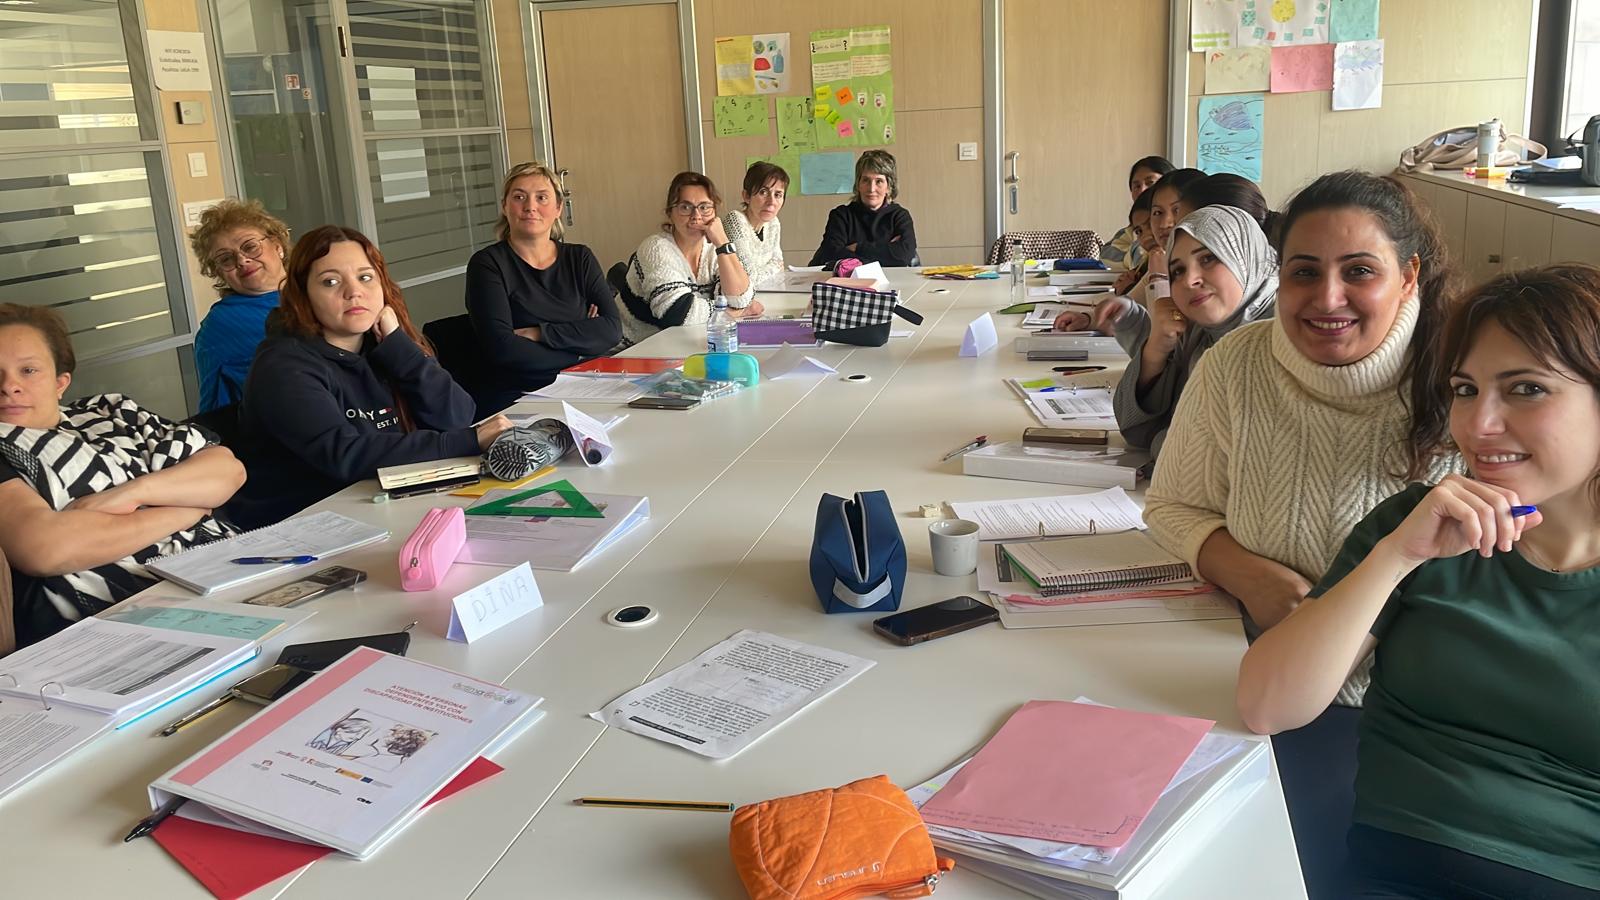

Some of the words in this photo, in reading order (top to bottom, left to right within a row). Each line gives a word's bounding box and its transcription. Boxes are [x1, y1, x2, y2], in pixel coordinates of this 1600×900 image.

[363, 687, 413, 705] DISCAPACIDAD
[423, 705, 474, 723] INSTITUCIONES
[385, 688, 434, 706] DEPENDIENTES
[446, 706, 463, 714] CON
[431, 696, 468, 710] PERSONAS
